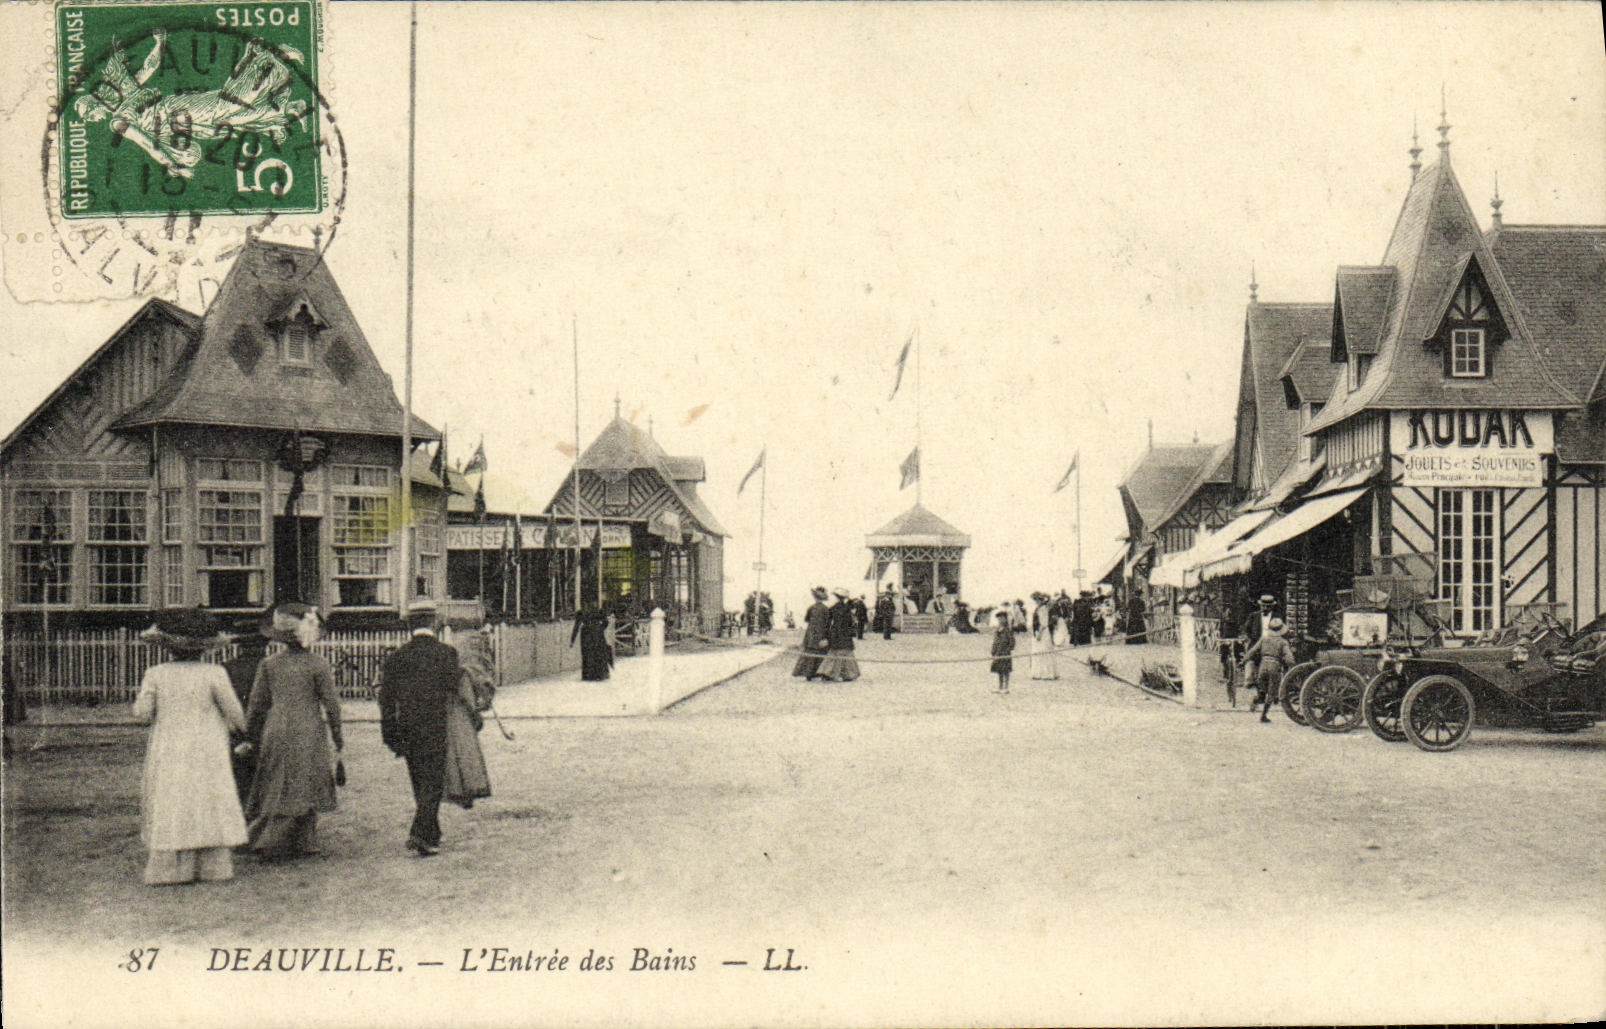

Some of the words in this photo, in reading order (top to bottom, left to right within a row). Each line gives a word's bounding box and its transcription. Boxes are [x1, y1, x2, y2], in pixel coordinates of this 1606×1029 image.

[216, 8, 300, 26] POSTES
[1407, 408, 1536, 450] KODAK
[1405, 455, 1452, 471] JOUETS
[1472, 454, 1536, 471] SOUVENIRS
